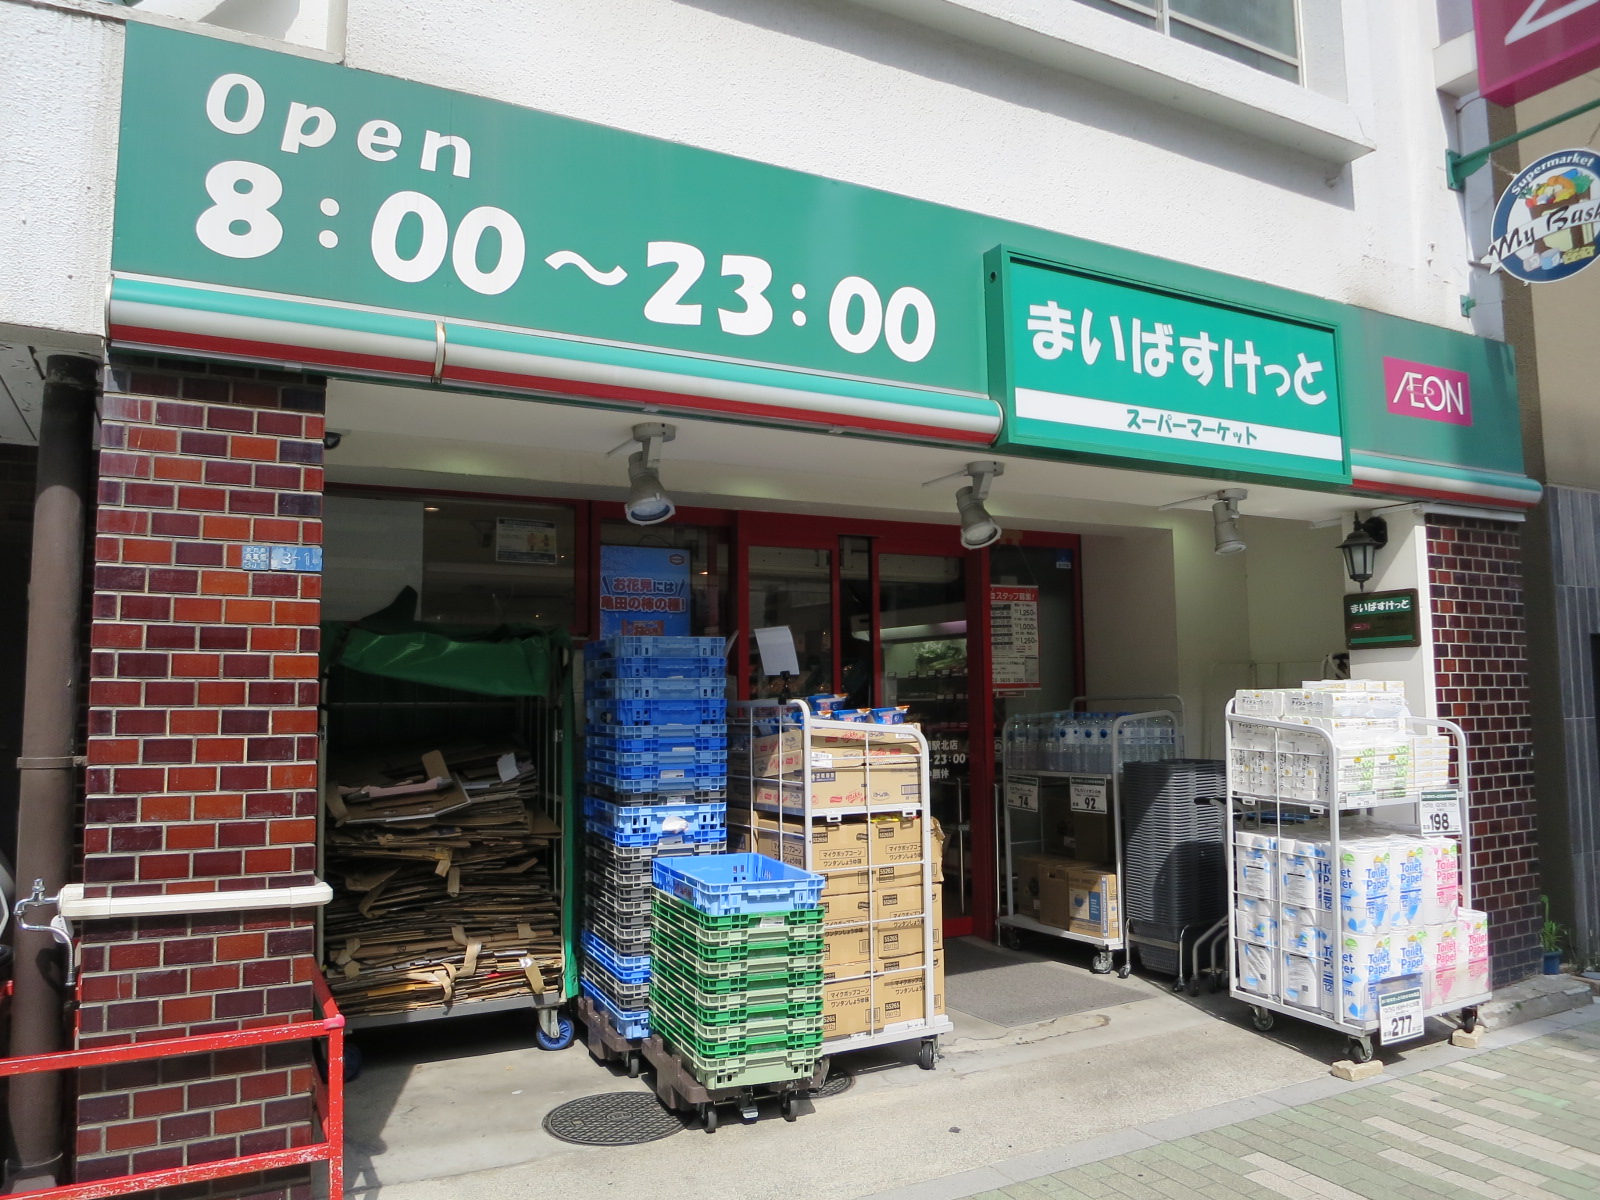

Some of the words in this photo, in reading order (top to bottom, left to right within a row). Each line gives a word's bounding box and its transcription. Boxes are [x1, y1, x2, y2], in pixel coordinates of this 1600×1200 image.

[206, 73, 471, 178] Open
[1511, 153, 1595, 195] Supermarket
[1489, 227, 1535, 260] My
[1027, 301, 1327, 405] まいばすけっと
[1126, 408, 1258, 445] スーパーマーケット
[613, 577, 676, 594] お花見には
[1351, 600, 1410, 614] まいばすけっと
[1085, 797, 1096, 810] 92
[1430, 813, 1450, 831] 198
[1365, 867, 1388, 879] Toilet
[1400, 862, 1422, 873] Toilet
[1401, 874, 1423, 884] Paper
[1437, 871, 1457, 882] Paper
[1367, 880, 1389, 891] Paper
[1468, 933, 1488, 945] Toilet
[1400, 947, 1423, 958] Toilet
[1436, 942, 1456, 953] Toilet
[1368, 952, 1390, 964] Toilet
[1401, 958, 1424, 969] Paper
[1437, 954, 1456, 965] Paper
[1369, 965, 1391, 976] Paper
[830, 988, 870, 999] マイクポップコーン
[1392, 1015, 1412, 1037] 277
